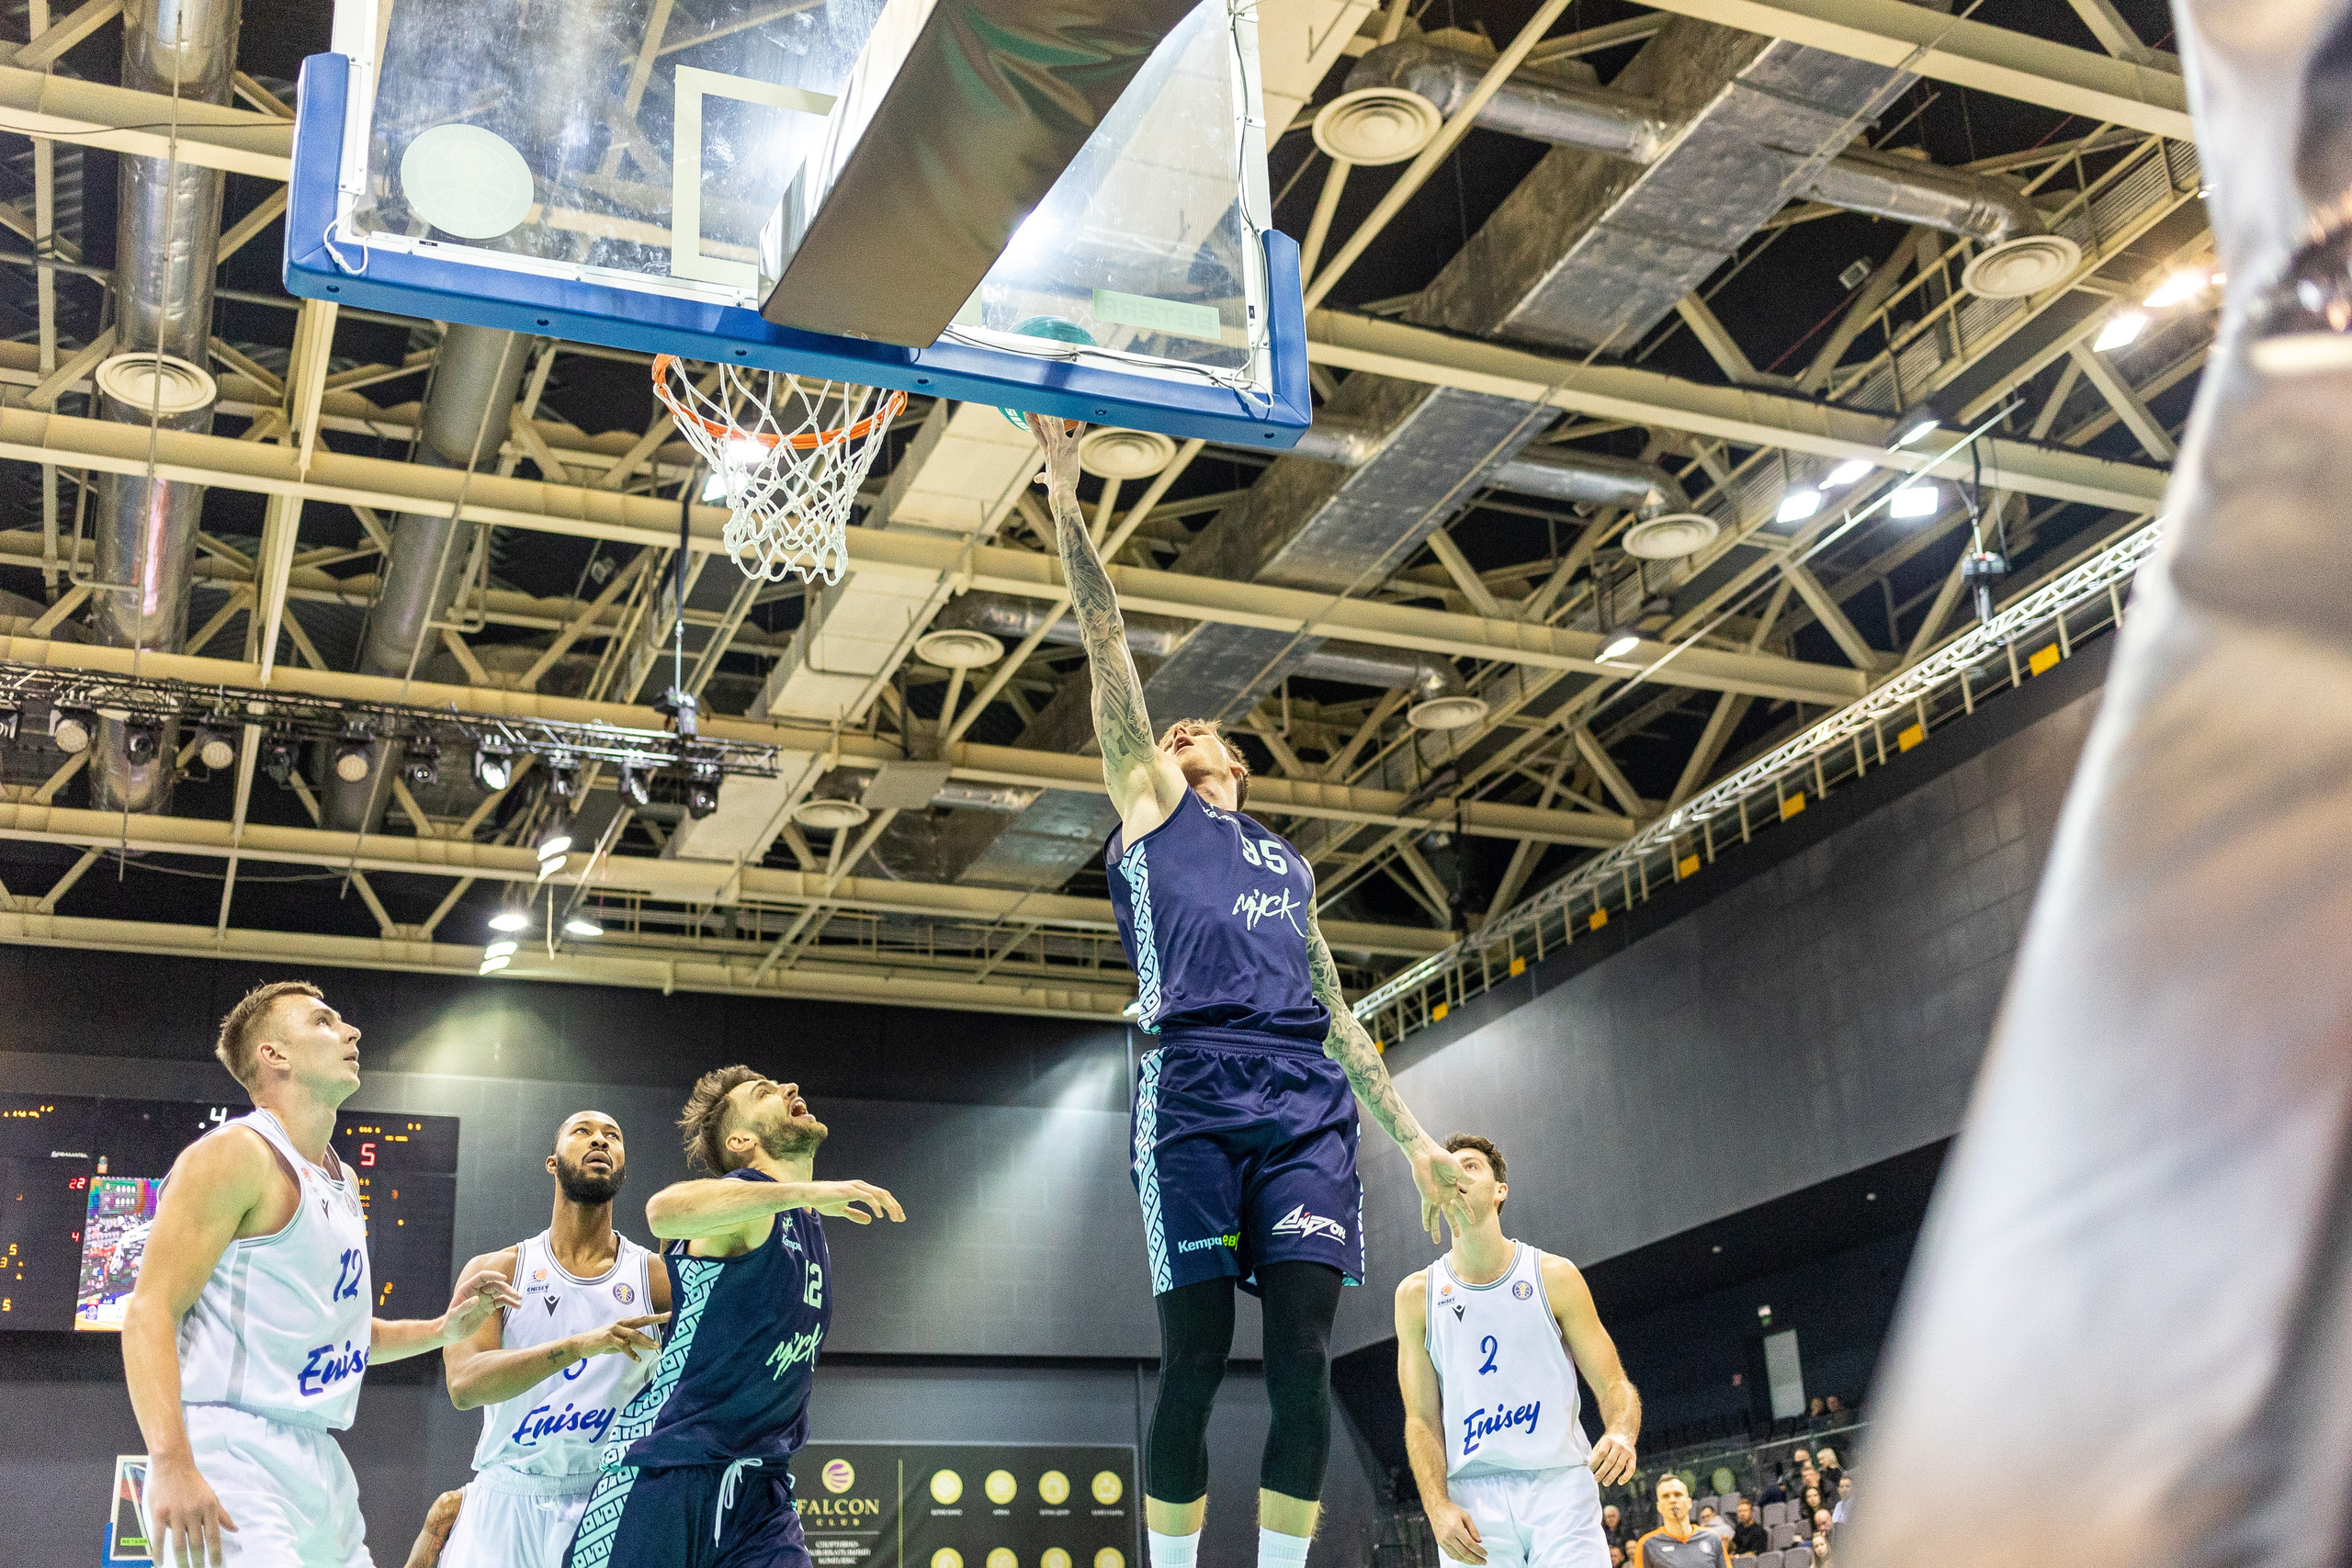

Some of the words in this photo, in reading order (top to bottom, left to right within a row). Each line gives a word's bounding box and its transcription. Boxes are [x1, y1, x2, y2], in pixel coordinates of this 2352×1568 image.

[1240, 832, 1288, 875] 95
[360, 1143, 376, 1167] 5
[69, 1177, 86, 1190] 22
[1178, 1236, 1222, 1254] Kempa
[333, 1248, 363, 1303] 12
[803, 1258, 823, 1310] 12
[2, 1298, 11, 1312] 5
[1477, 1335, 1498, 1376] 2
[512, 1403, 616, 1447] Enisey
[1463, 1400, 1542, 1456] Enisey
[797, 1498, 880, 1516] FALCON
